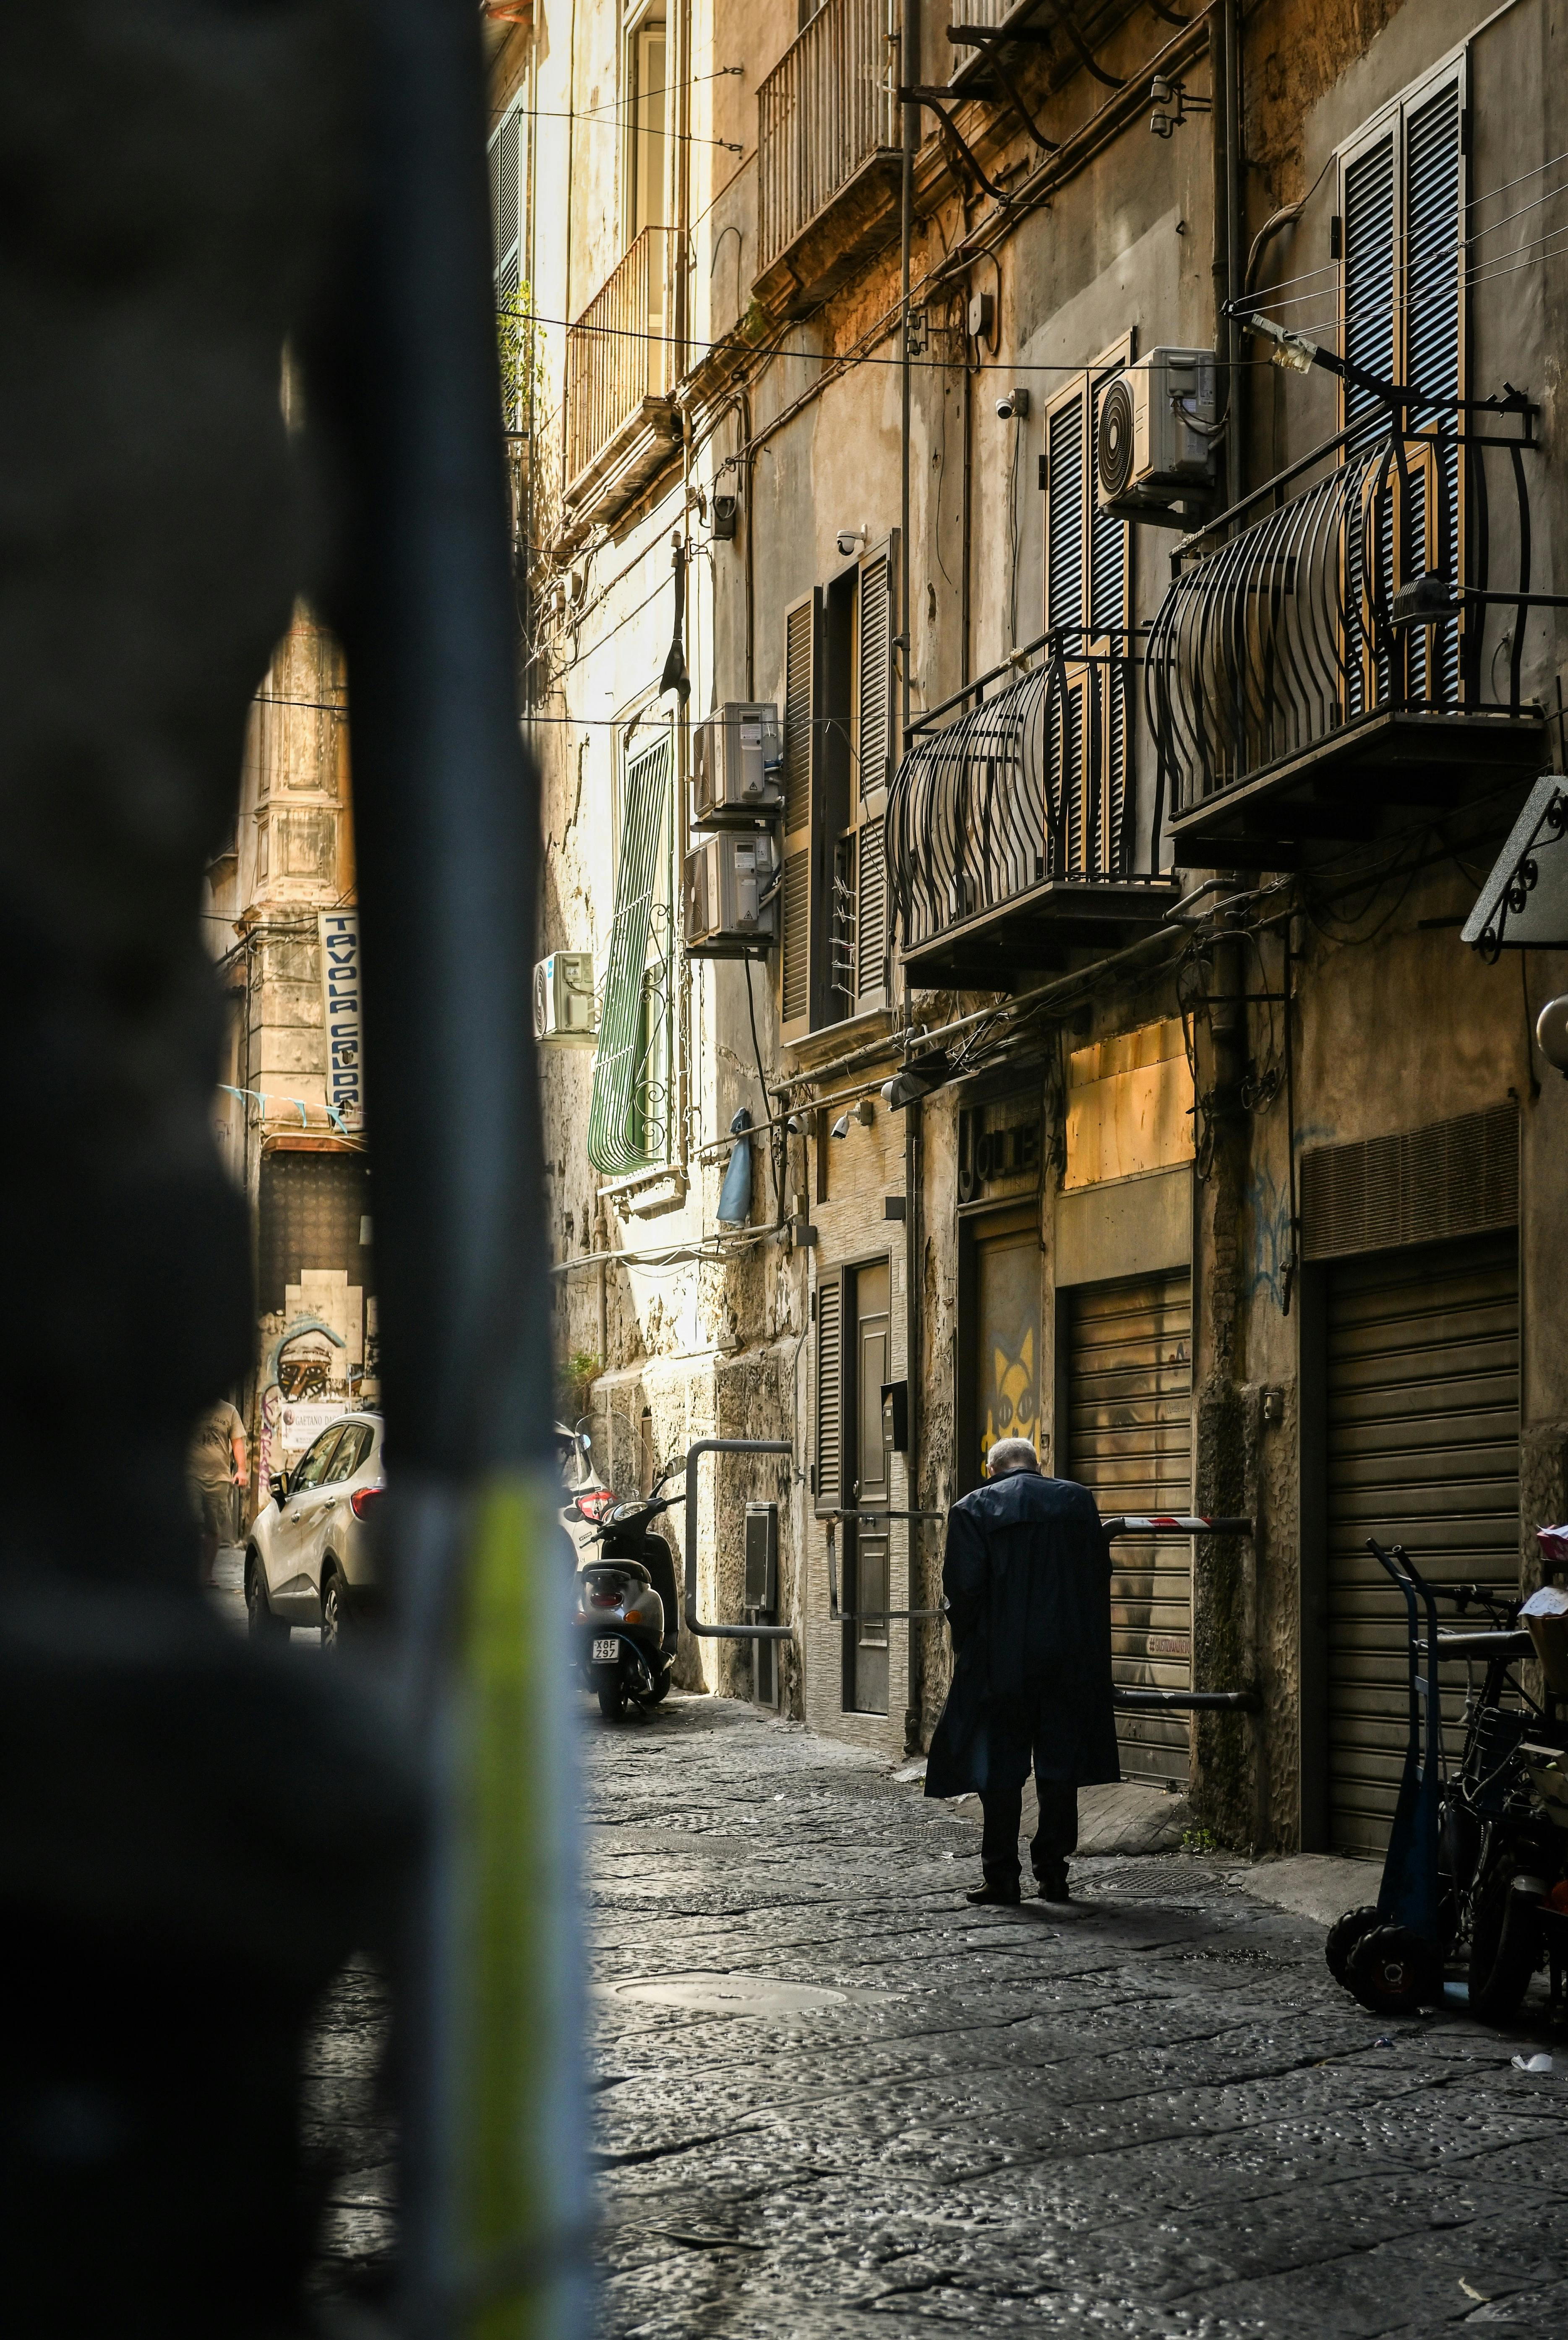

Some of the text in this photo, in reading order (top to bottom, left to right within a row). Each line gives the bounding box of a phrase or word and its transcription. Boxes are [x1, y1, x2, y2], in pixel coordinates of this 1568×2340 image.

[326, 917, 357, 1014] TAVOLA
[331, 1023, 359, 1103] CALDA
[295, 1415, 322, 1426] GAETANO
[597, 1640, 616, 1649] X8F
[596, 1649, 615, 1658] Z97
